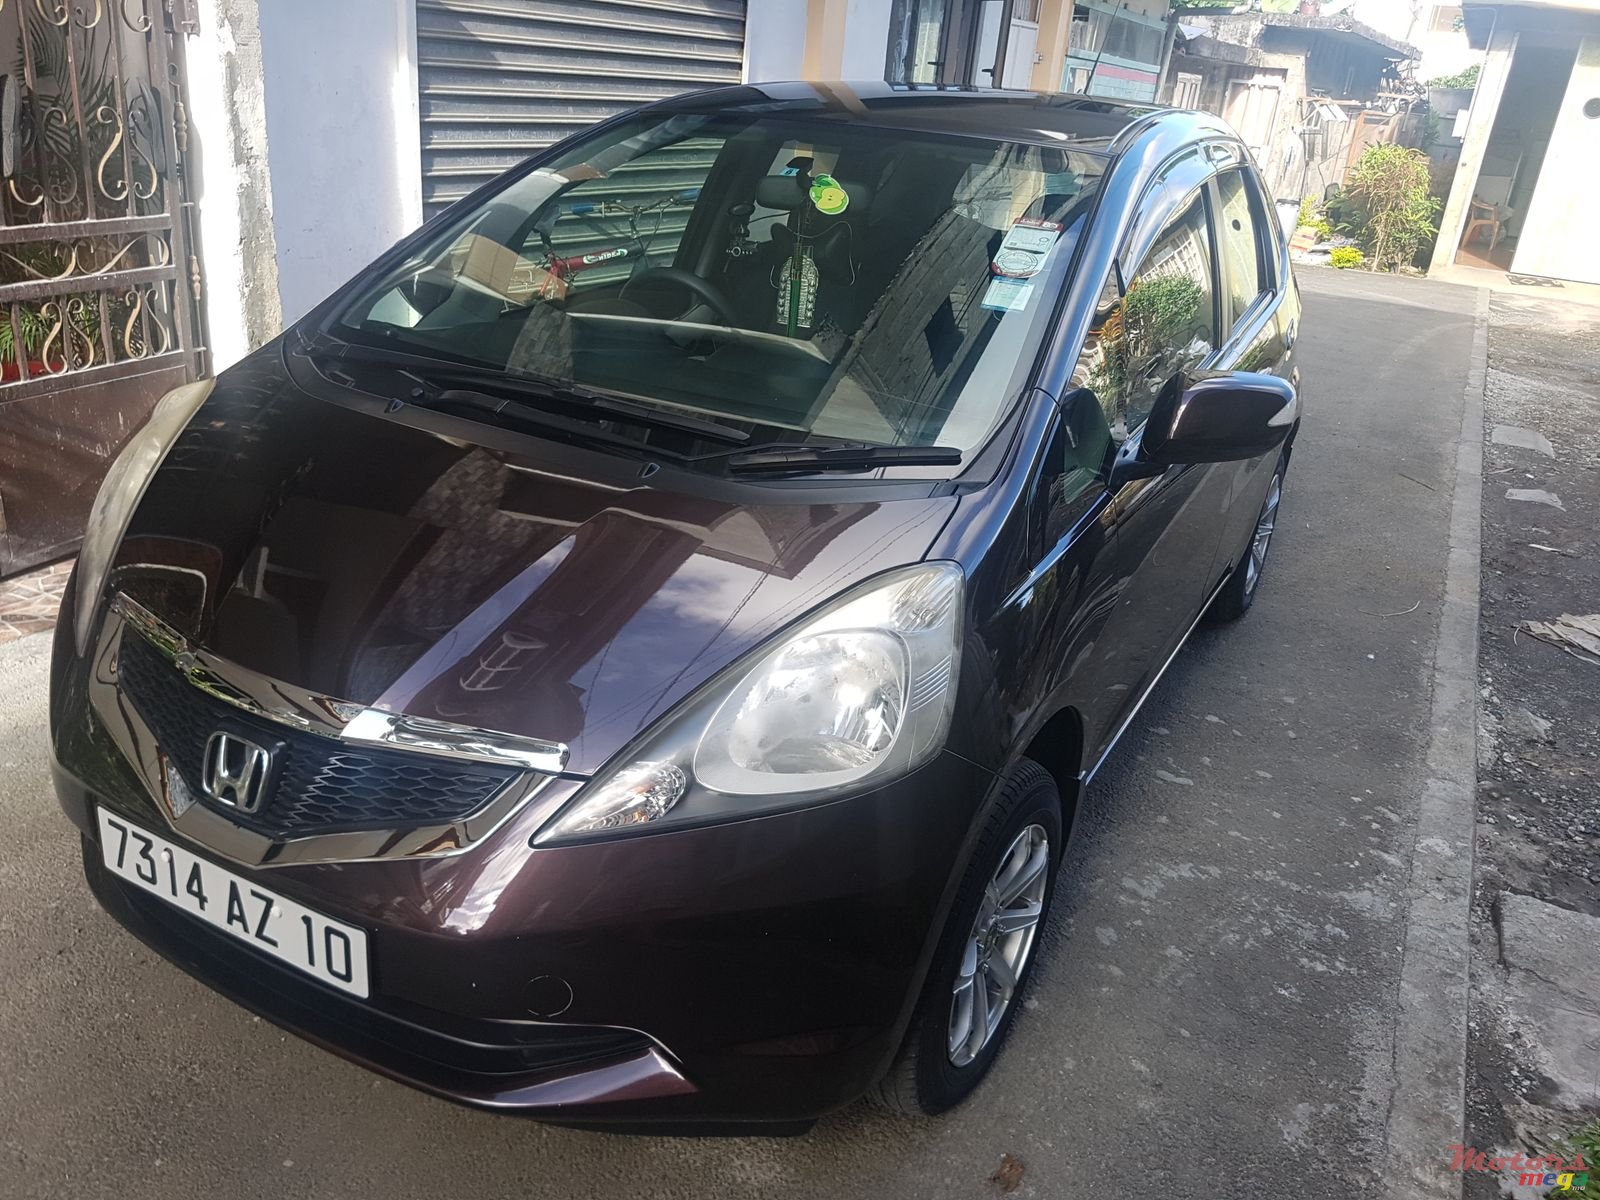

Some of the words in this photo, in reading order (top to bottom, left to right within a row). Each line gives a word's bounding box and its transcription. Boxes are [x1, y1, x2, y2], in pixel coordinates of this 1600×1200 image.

[107, 818, 208, 912] 7314
[226, 879, 279, 949] AZ
[301, 914, 353, 984] 10
